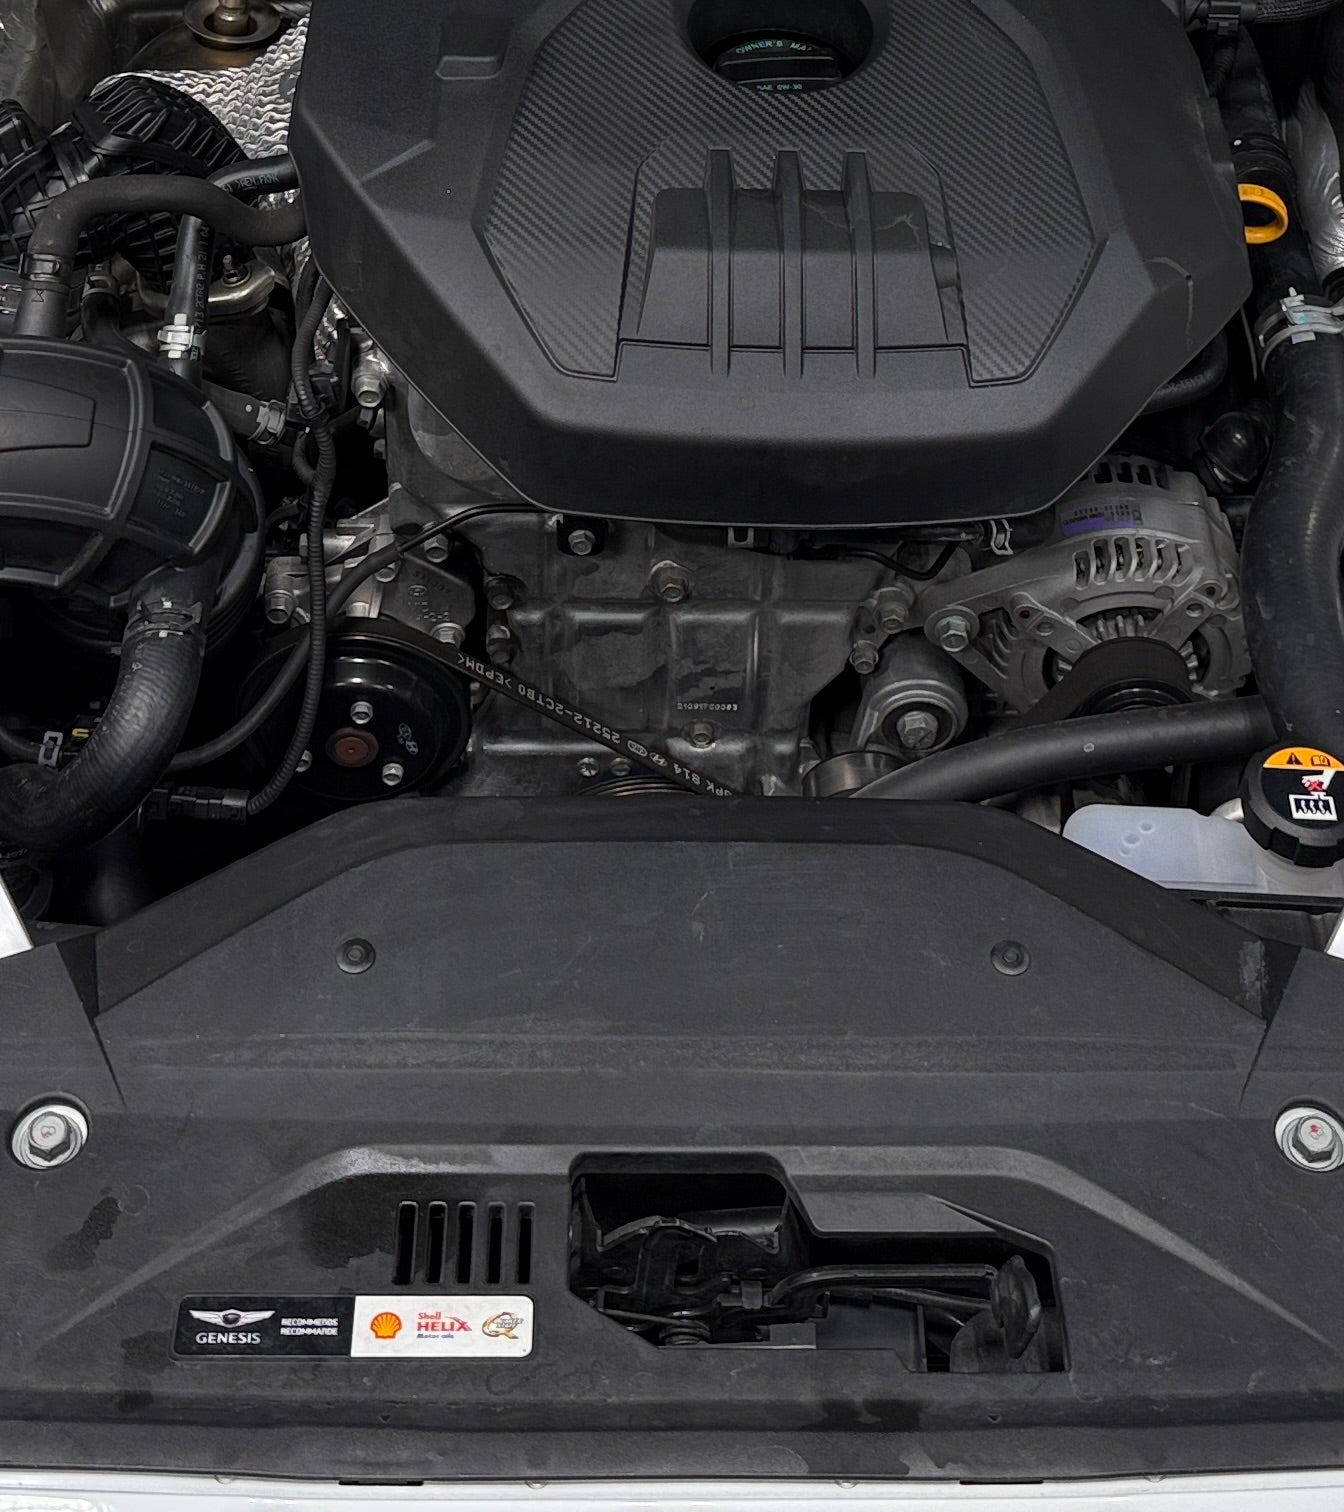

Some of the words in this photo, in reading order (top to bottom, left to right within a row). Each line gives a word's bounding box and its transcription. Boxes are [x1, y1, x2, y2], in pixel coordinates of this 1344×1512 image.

[456, 651, 513, 690] >EPDM<
[517, 683, 622, 745] 25212-2CTB0
[418, 1312, 442, 1320] Shell
[417, 1321, 471, 1332] HELIX
[195, 1332, 261, 1345] GENESIS
